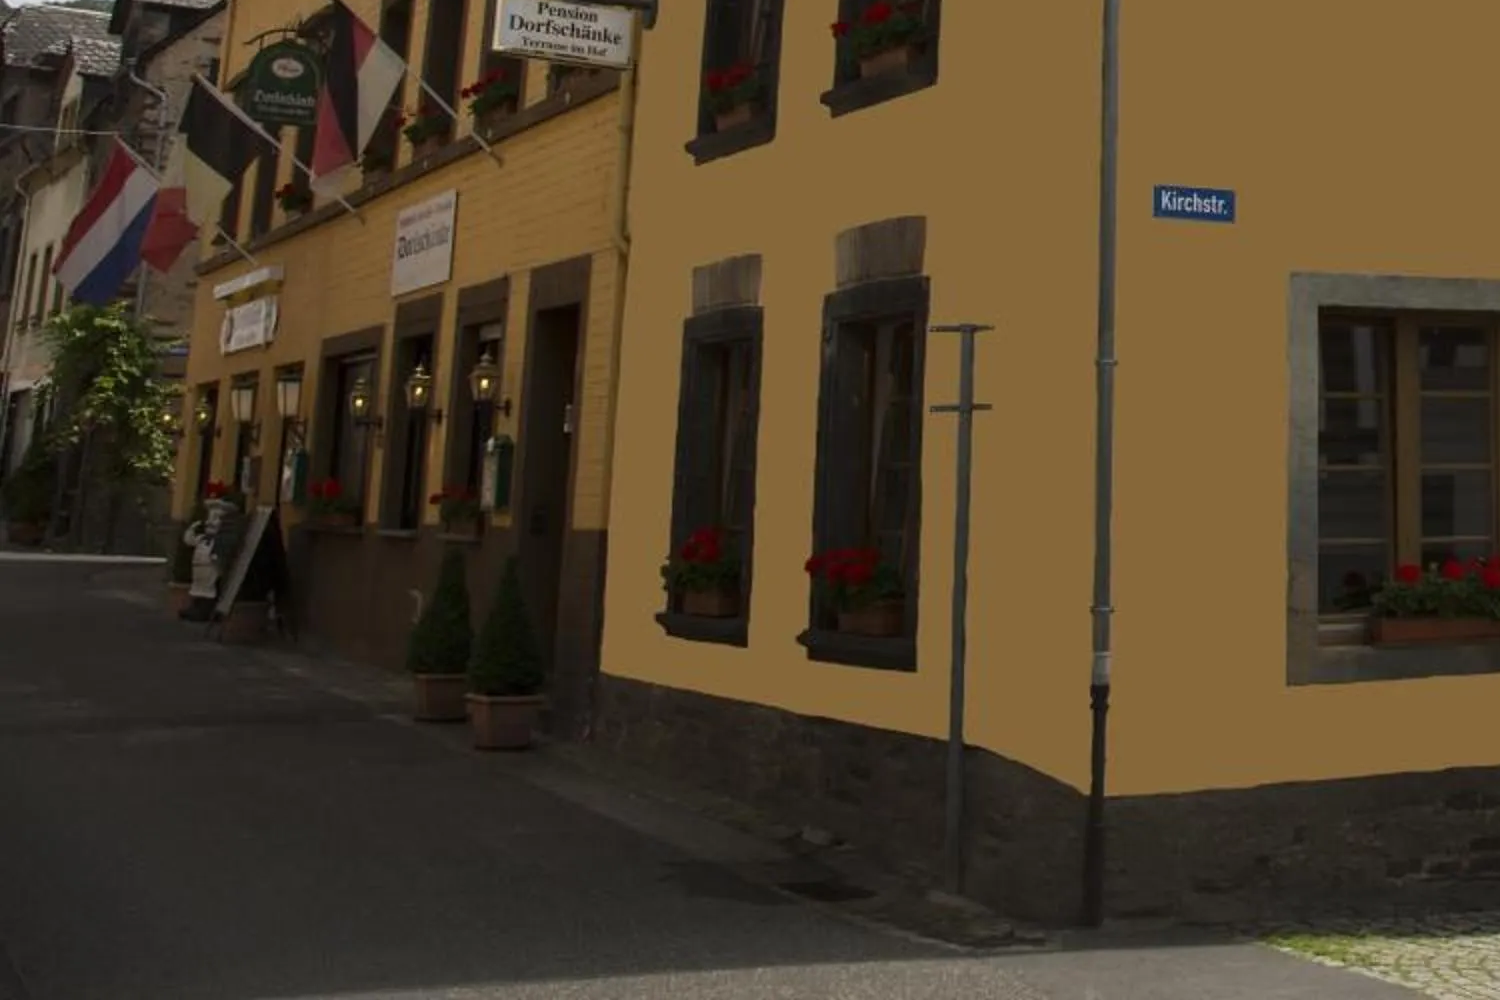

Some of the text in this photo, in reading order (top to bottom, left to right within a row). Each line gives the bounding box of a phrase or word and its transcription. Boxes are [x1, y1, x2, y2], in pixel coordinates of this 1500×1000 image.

[536, 1, 598, 24] Pension
[508, 13, 623, 46] Dorfschänke
[1160, 189, 1229, 216] Kirchstr.
